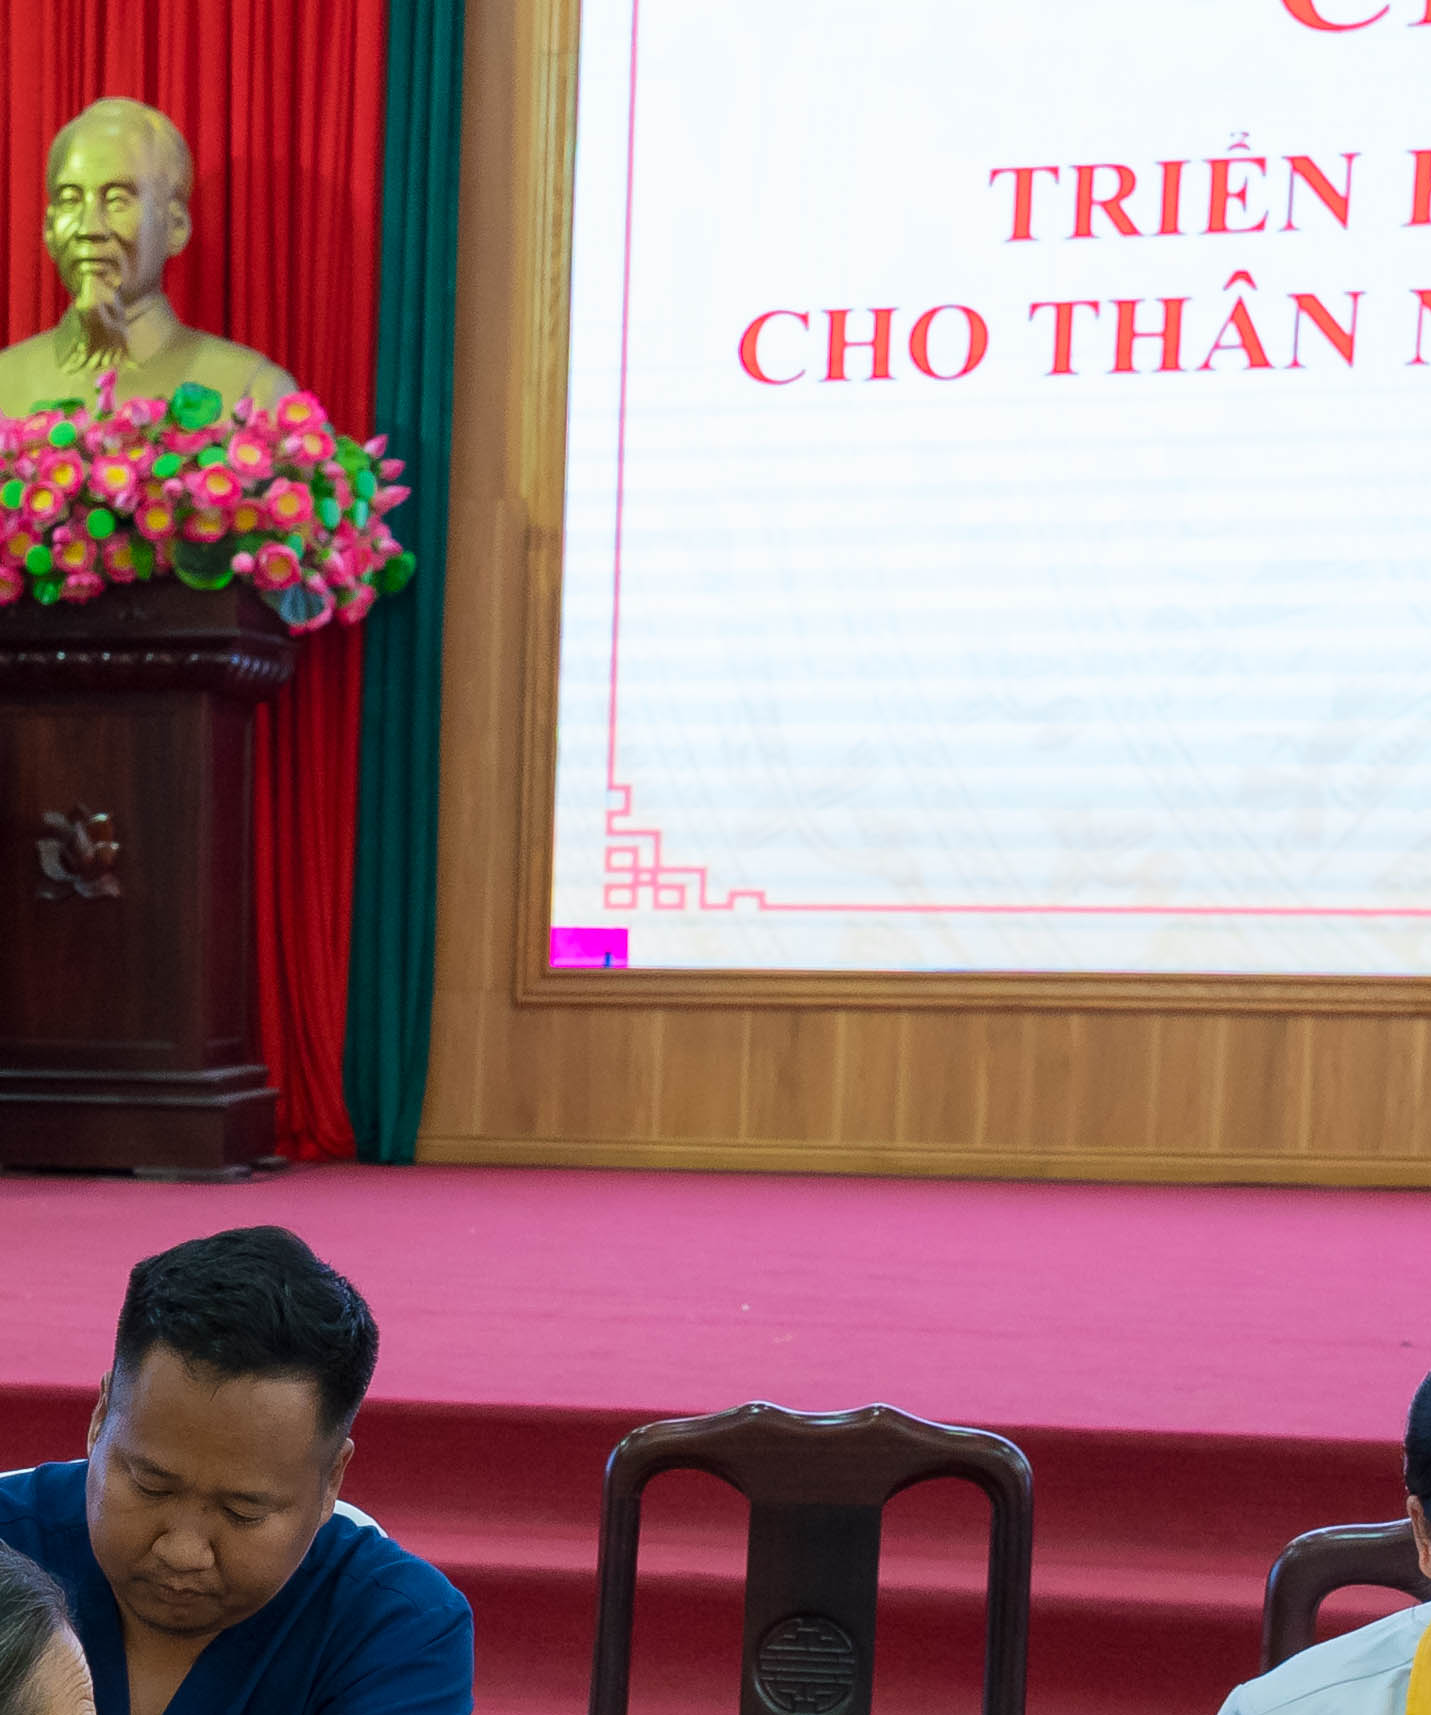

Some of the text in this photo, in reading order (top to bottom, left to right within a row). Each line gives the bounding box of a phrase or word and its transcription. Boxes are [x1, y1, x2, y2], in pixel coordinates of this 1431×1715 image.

[988, 130, 1359, 242] TRIỂN
[736, 304, 991, 386] CHO
[1028, 269, 1366, 378] THÂN
